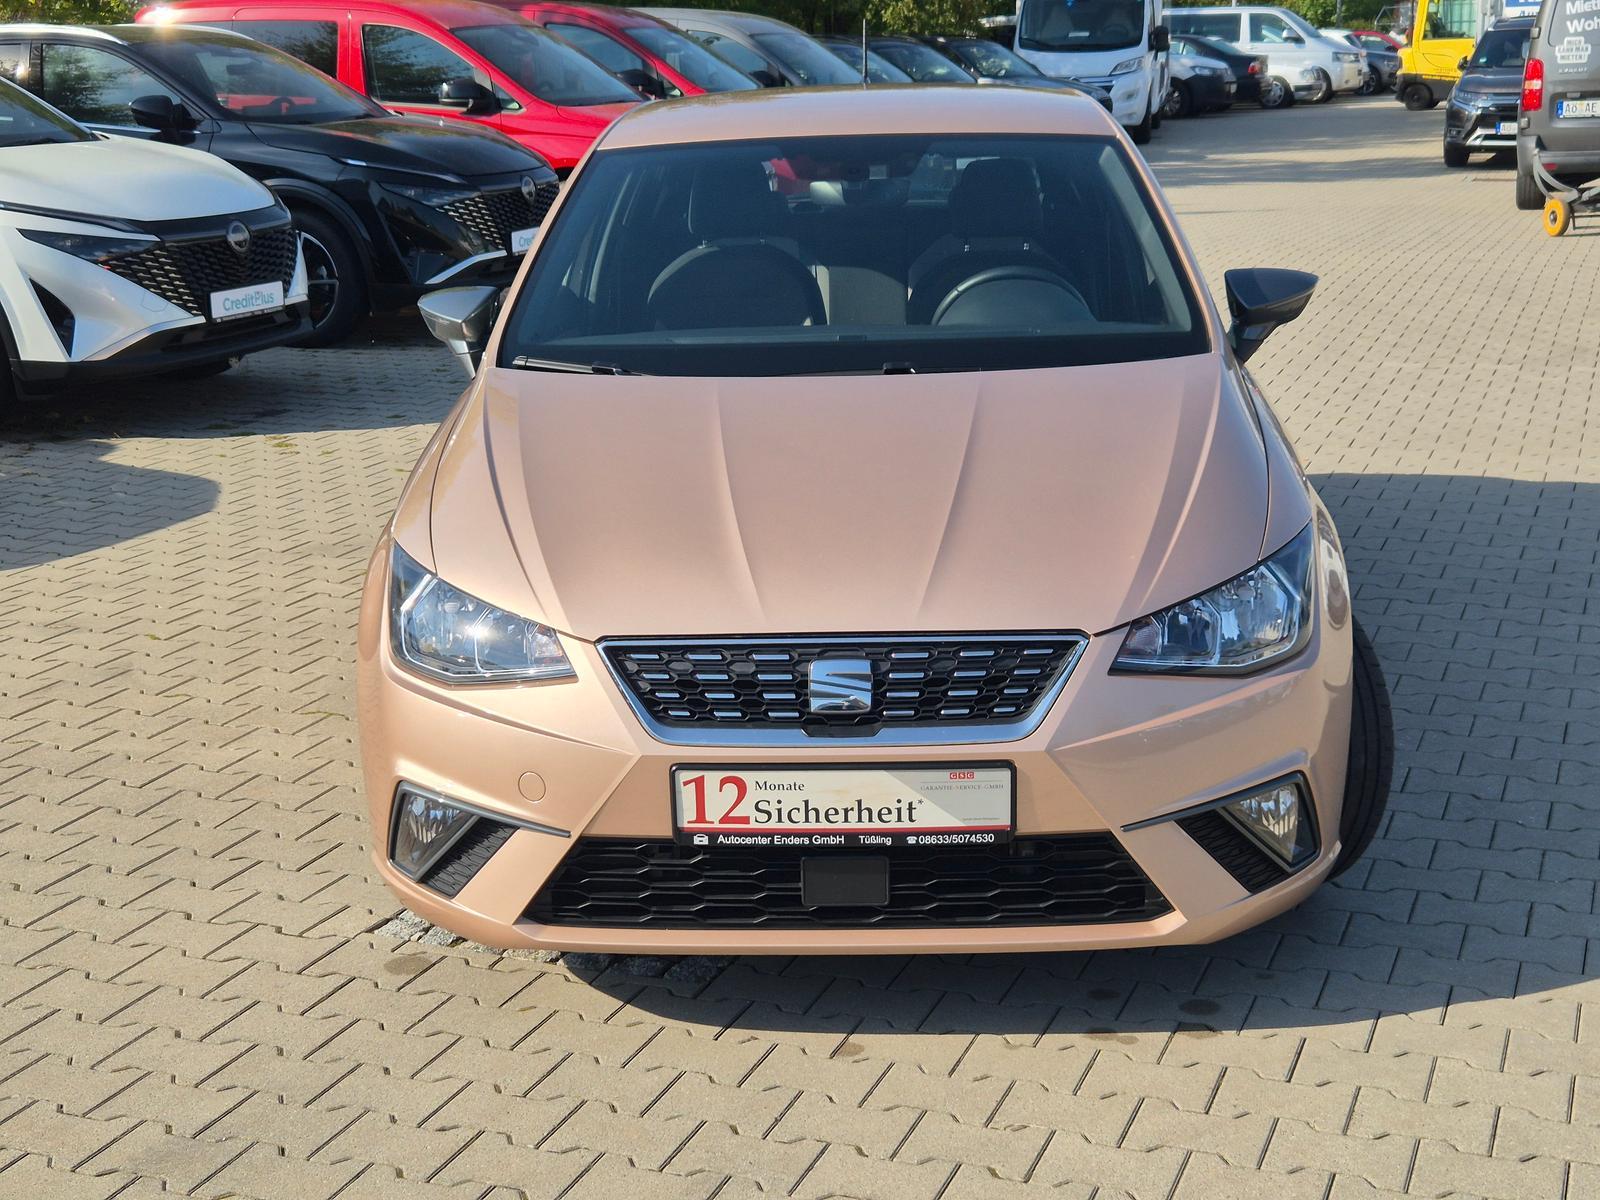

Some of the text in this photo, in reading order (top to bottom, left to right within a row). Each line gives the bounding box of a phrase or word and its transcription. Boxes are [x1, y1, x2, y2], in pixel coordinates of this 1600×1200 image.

[223, 291, 274, 311] CreditPlus
[949, 771, 975, 780] GSG
[754, 780, 805, 791] Monate
[682, 774, 750, 825] 12
[717, 833, 995, 846] Autocenter Enders GmbH Tüßling 08633/5074530
